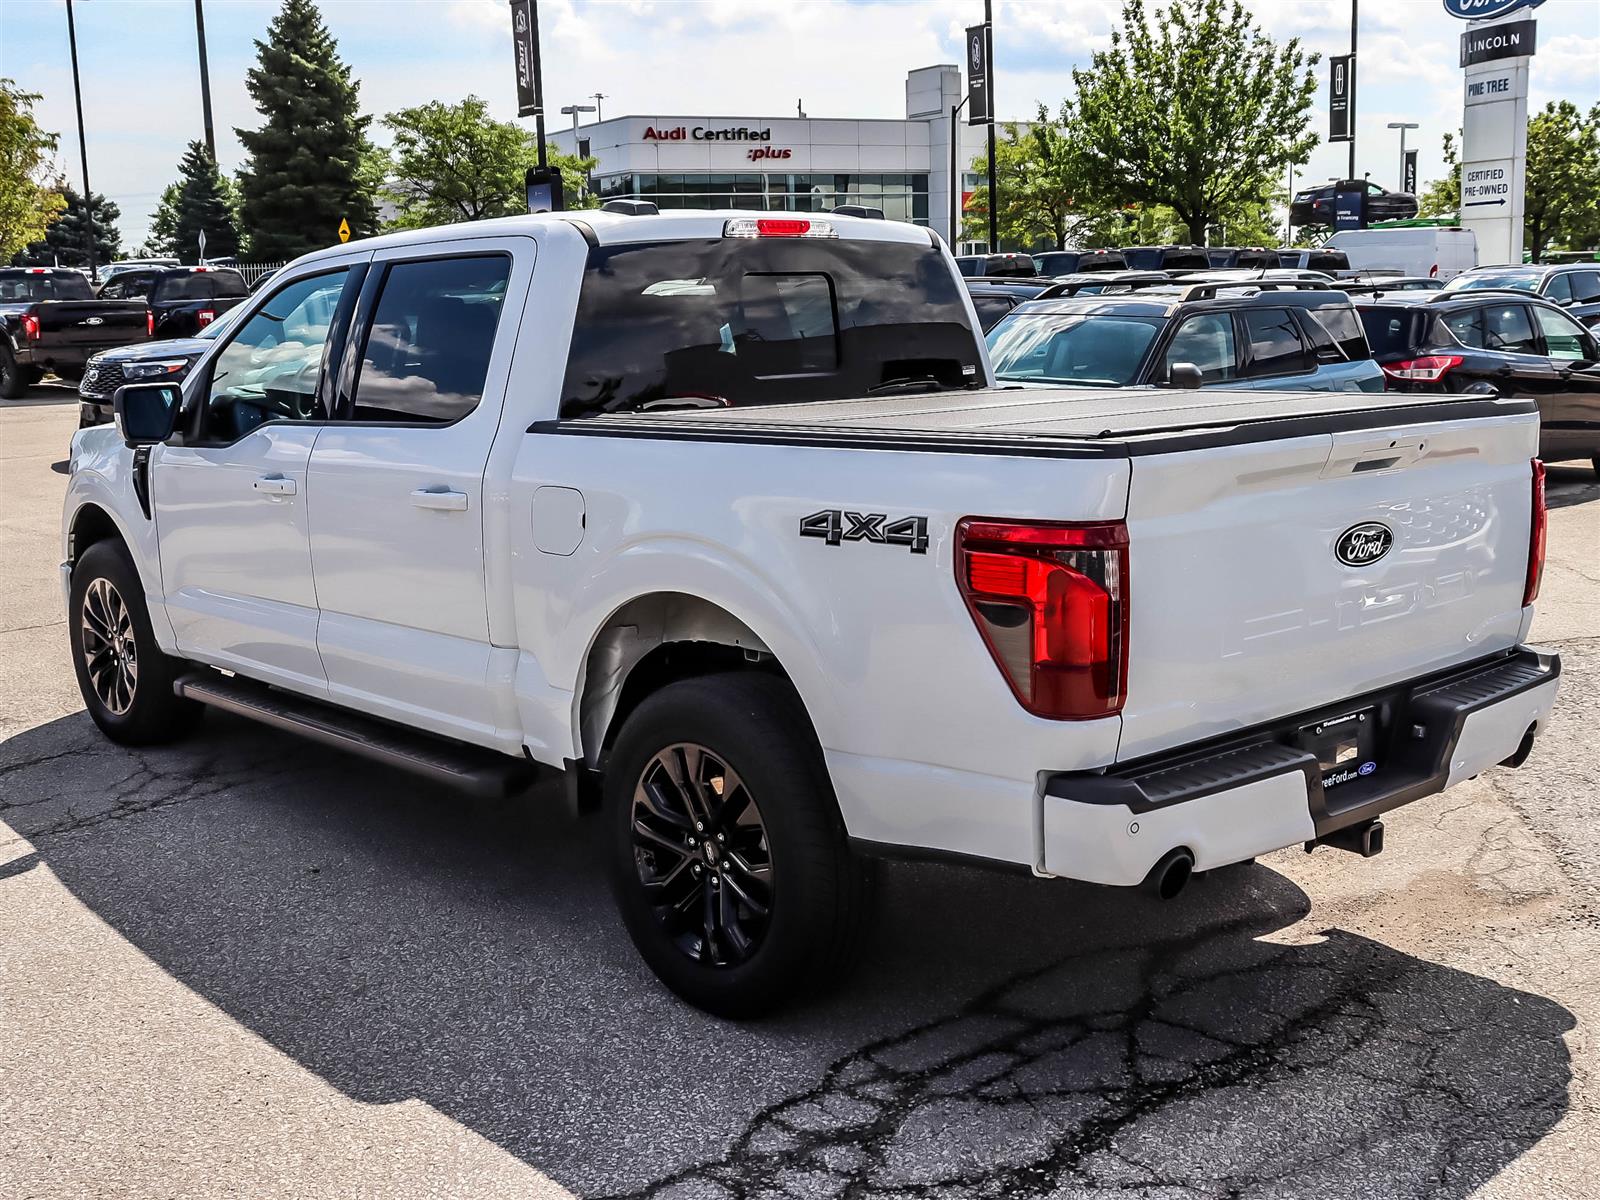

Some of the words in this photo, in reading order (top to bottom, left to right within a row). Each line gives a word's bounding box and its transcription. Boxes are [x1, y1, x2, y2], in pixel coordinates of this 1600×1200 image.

[1468, 33, 1520, 53] LINCOLN
[1468, 82, 1485, 96] PINE
[1486, 78, 1509, 92] TREE
[642, 126, 687, 140] Audi
[692, 127, 771, 141] Certified
[1467, 169, 1504, 182] CERTIFIED
[1464, 184, 1508, 197] PRE-OWNED
[1347, 530, 1385, 560] Ford
[1321, 770, 1358, 788] reeFord.com
